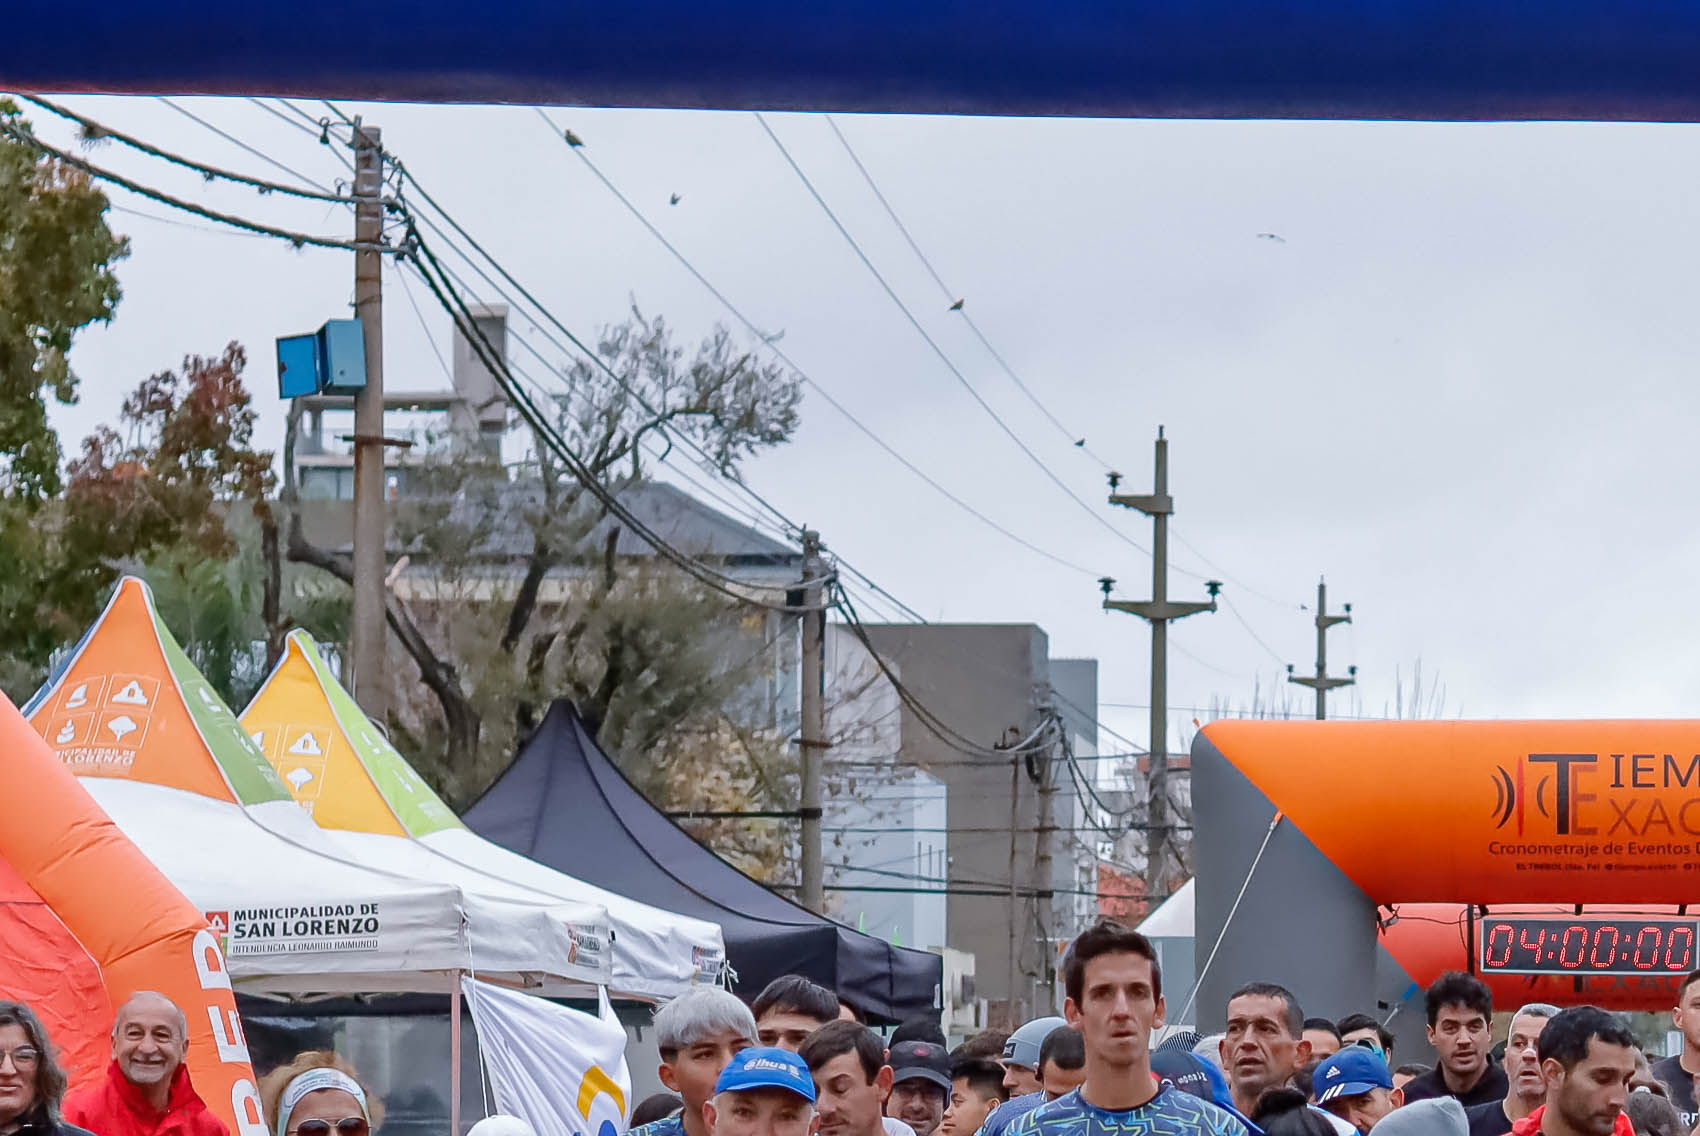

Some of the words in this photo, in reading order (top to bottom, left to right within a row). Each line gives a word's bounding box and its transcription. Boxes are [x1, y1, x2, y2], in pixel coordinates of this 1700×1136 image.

[1488, 841, 1599, 857] Cronometraje
[1602, 841, 1623, 855] de
[1628, 841, 1690, 855] Eventos
[234, 905, 354, 921] MUNICIPALIDAD
[360, 903, 378, 915] DE
[234, 921, 276, 939] SAN
[282, 918, 379, 937] LORENZO
[1486, 925, 1693, 969] 04:00:00
